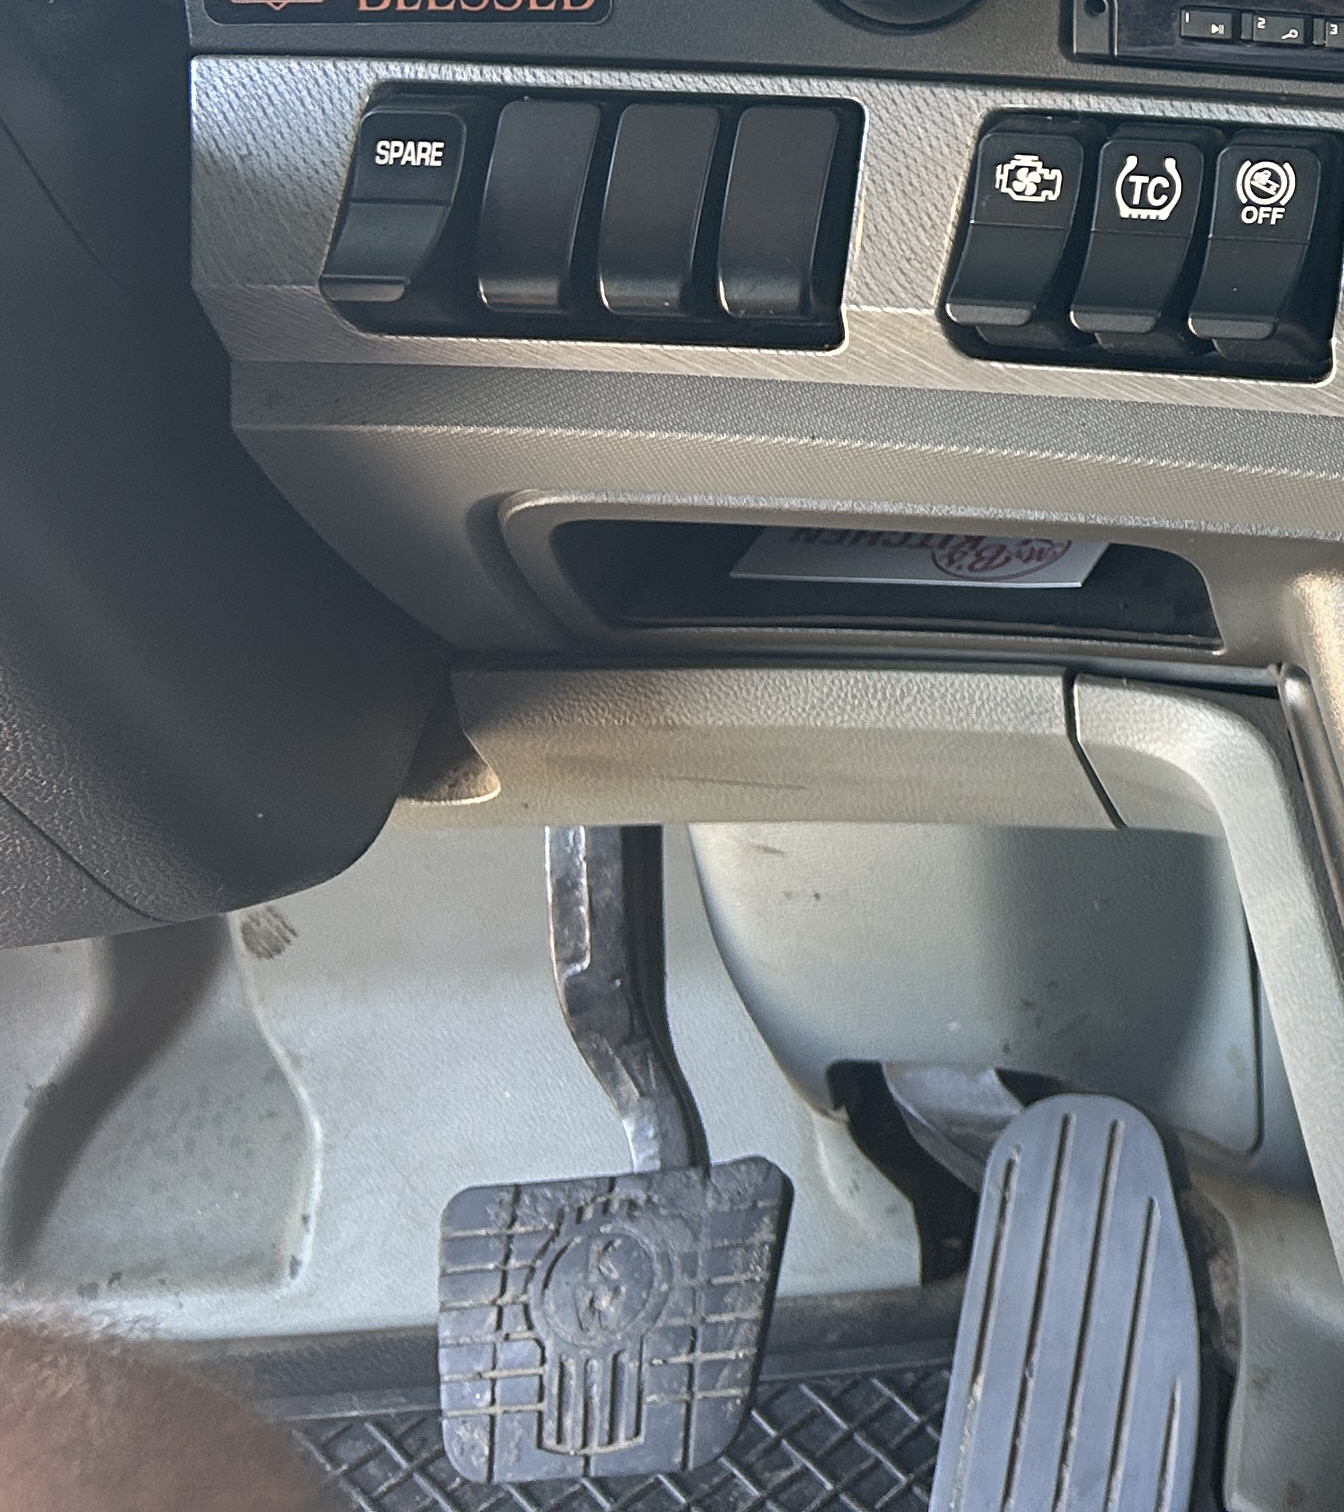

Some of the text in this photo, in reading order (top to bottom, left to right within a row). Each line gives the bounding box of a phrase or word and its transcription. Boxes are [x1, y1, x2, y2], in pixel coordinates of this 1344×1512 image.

[1256, 18, 1266, 29] 2
[1329, 24, 1338, 35] 3
[375, 140, 445, 168] SPARE
[1128, 175, 1170, 207] TC
[1241, 206, 1286, 226] OFF
